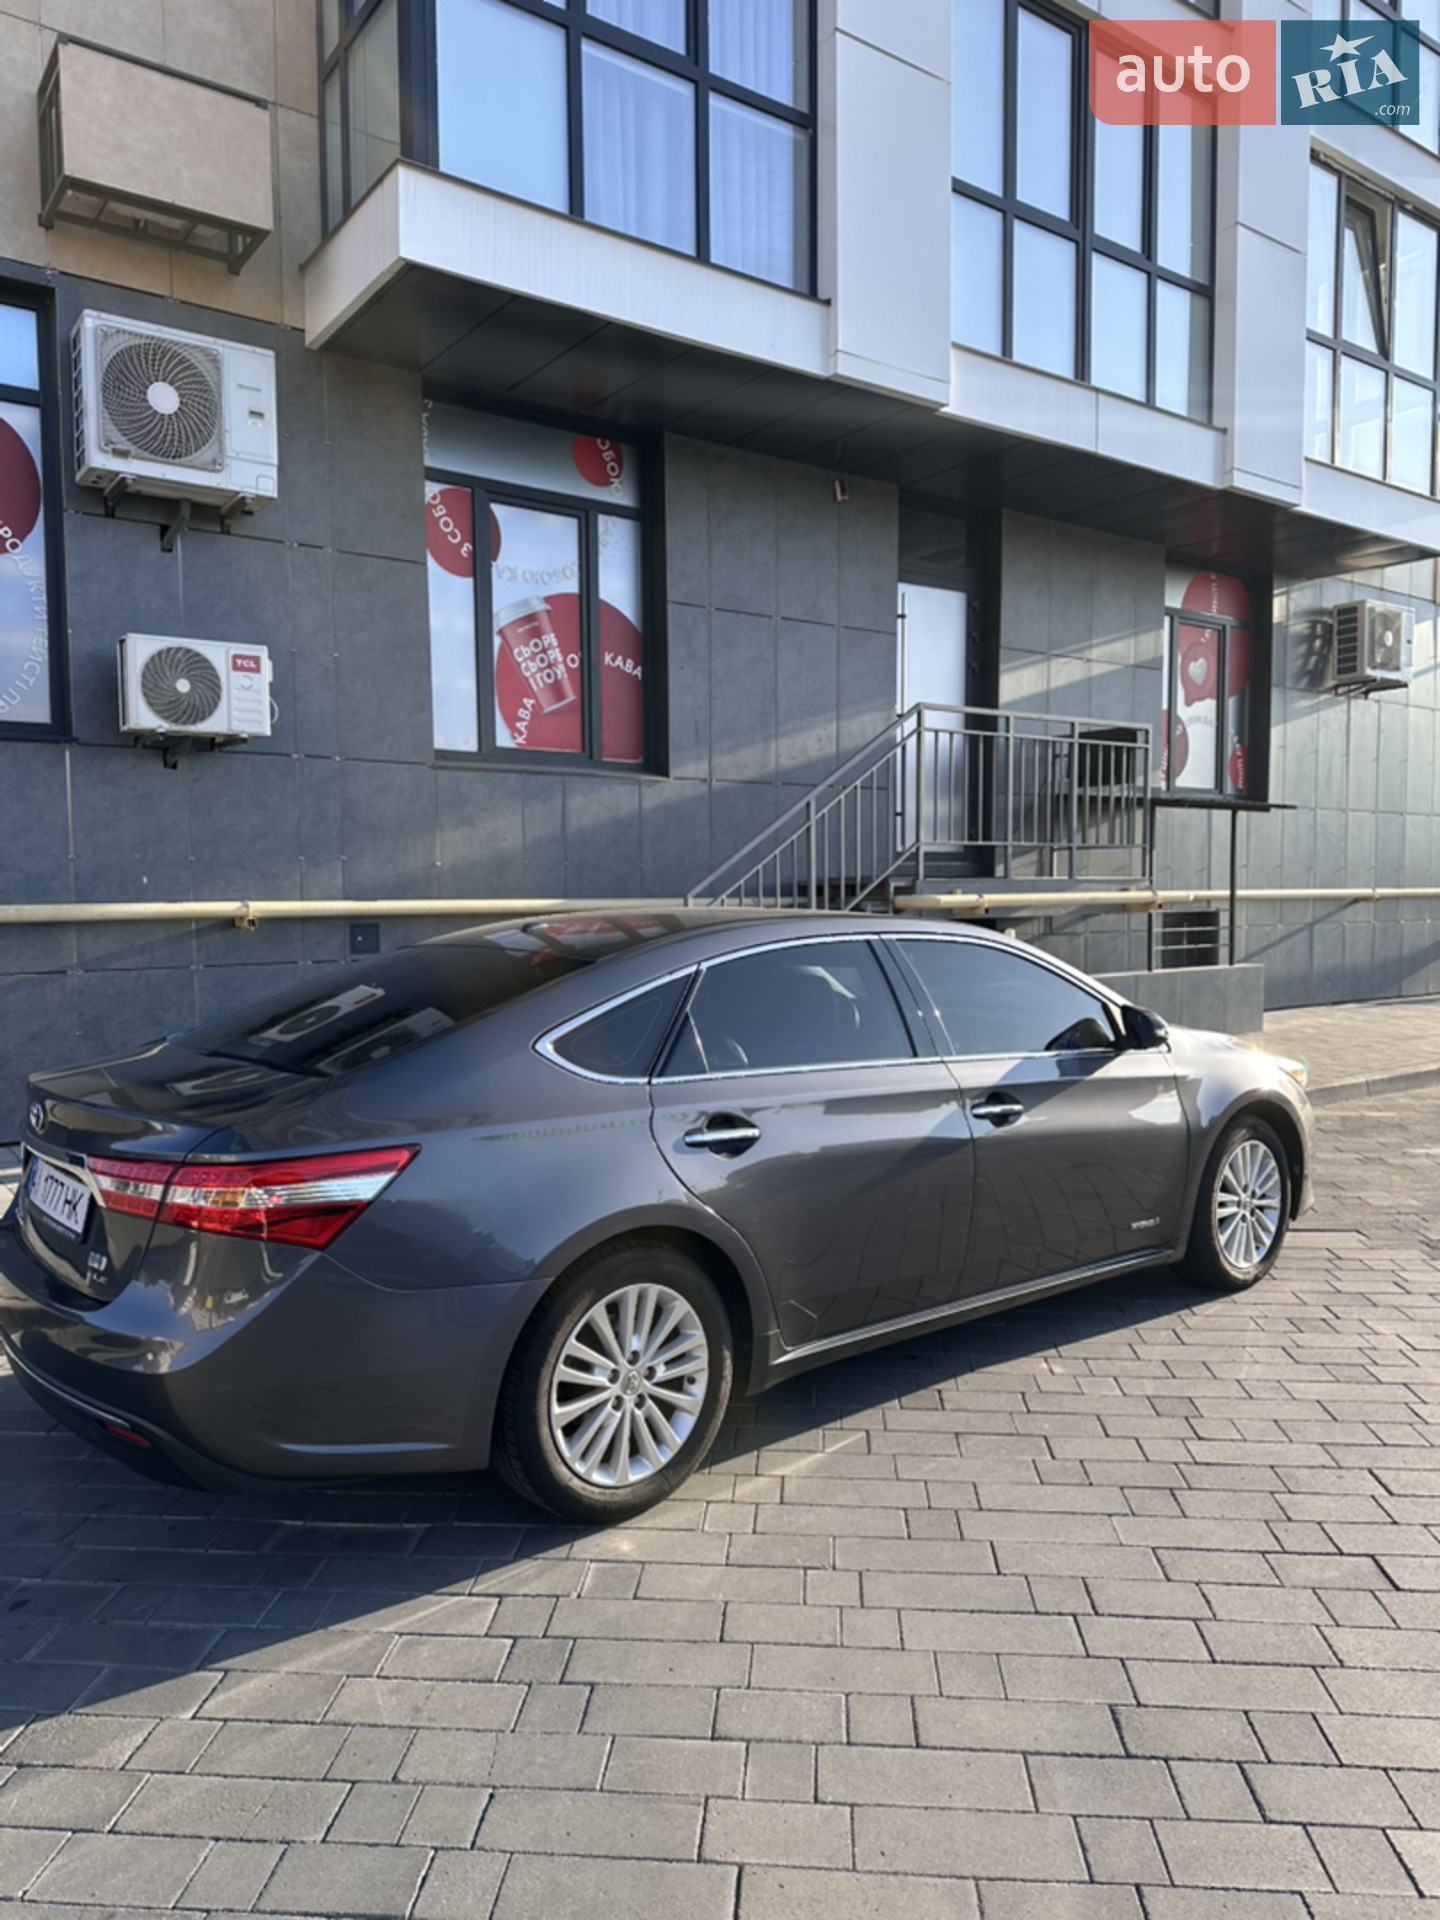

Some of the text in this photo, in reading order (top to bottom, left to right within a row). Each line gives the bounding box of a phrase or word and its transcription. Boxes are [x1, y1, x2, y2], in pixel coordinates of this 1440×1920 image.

[0, 519, 48, 622] РОДУКТИ
[236, 658, 258, 669] TCL
[513, 698, 536, 745] КАВА
[604, 651, 642, 681] КАВА
